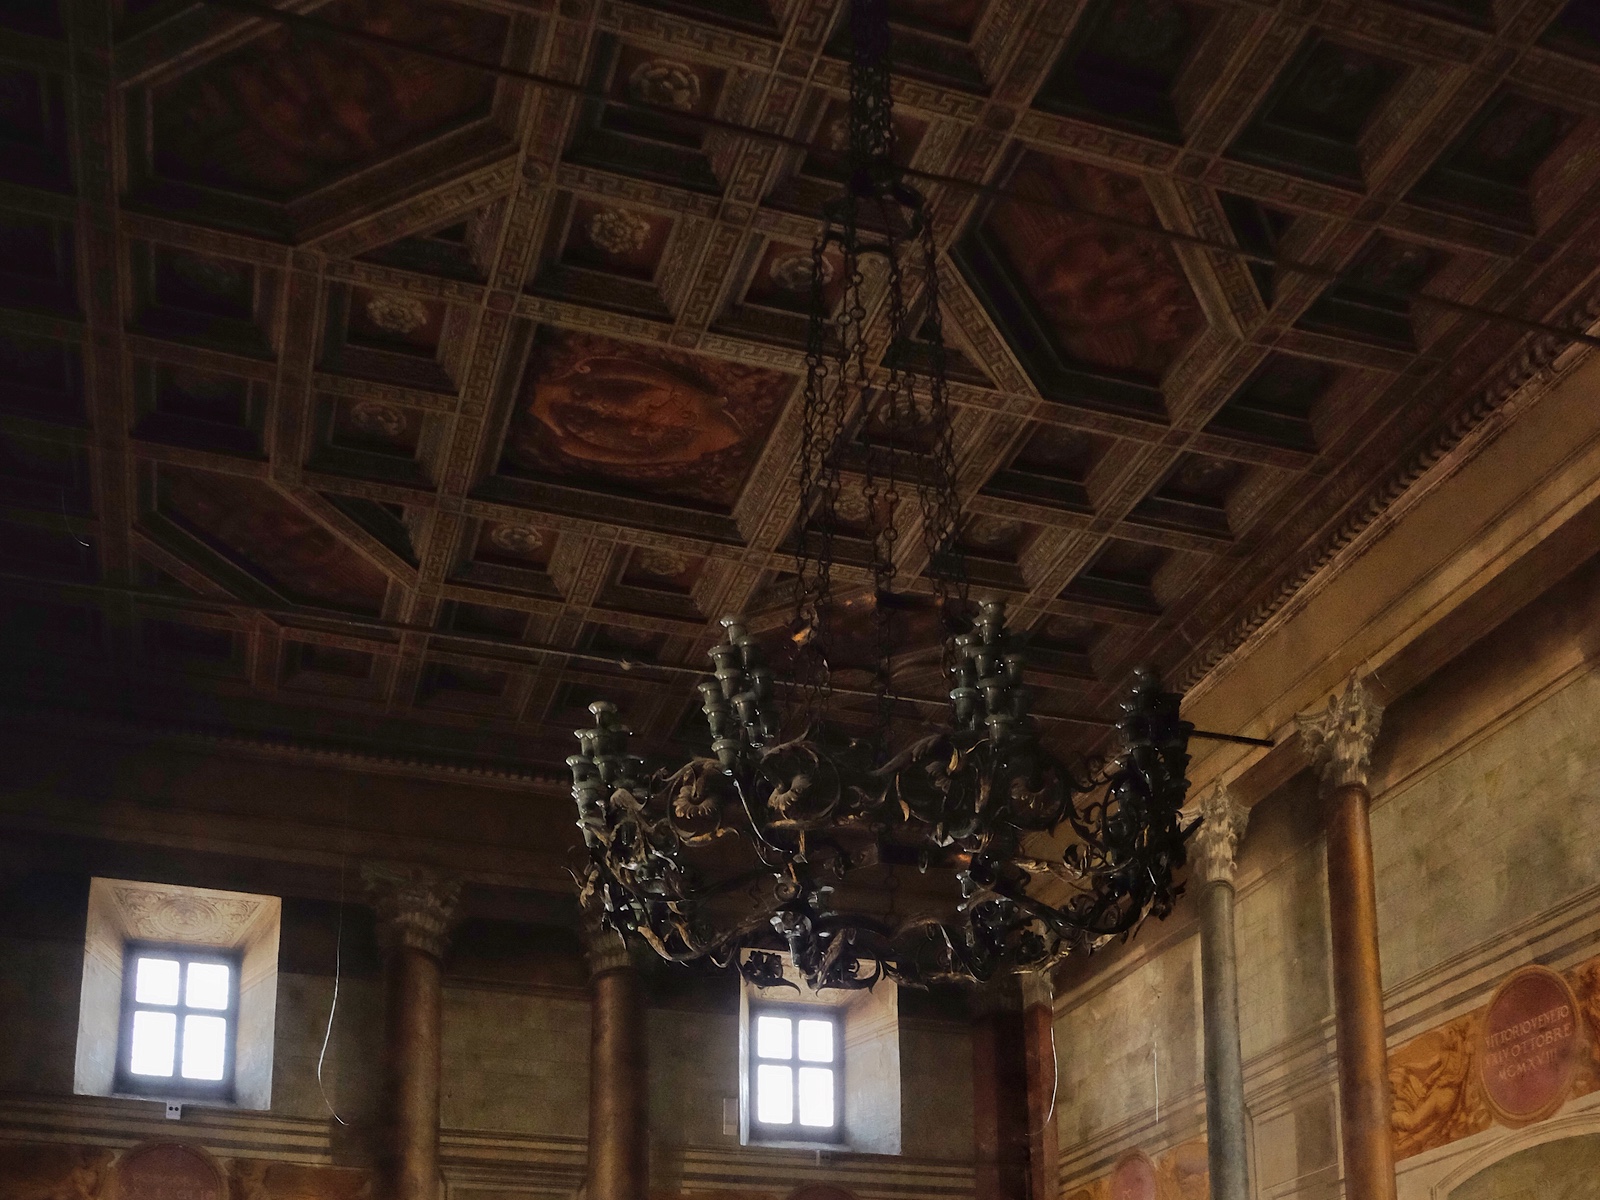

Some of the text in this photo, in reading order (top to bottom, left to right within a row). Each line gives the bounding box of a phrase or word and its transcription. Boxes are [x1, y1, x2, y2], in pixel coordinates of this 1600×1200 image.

[1484, 1005, 1569, 1048] VITTORIO VENETO
[1511, 1023, 1572, 1057] OTTOBRE
